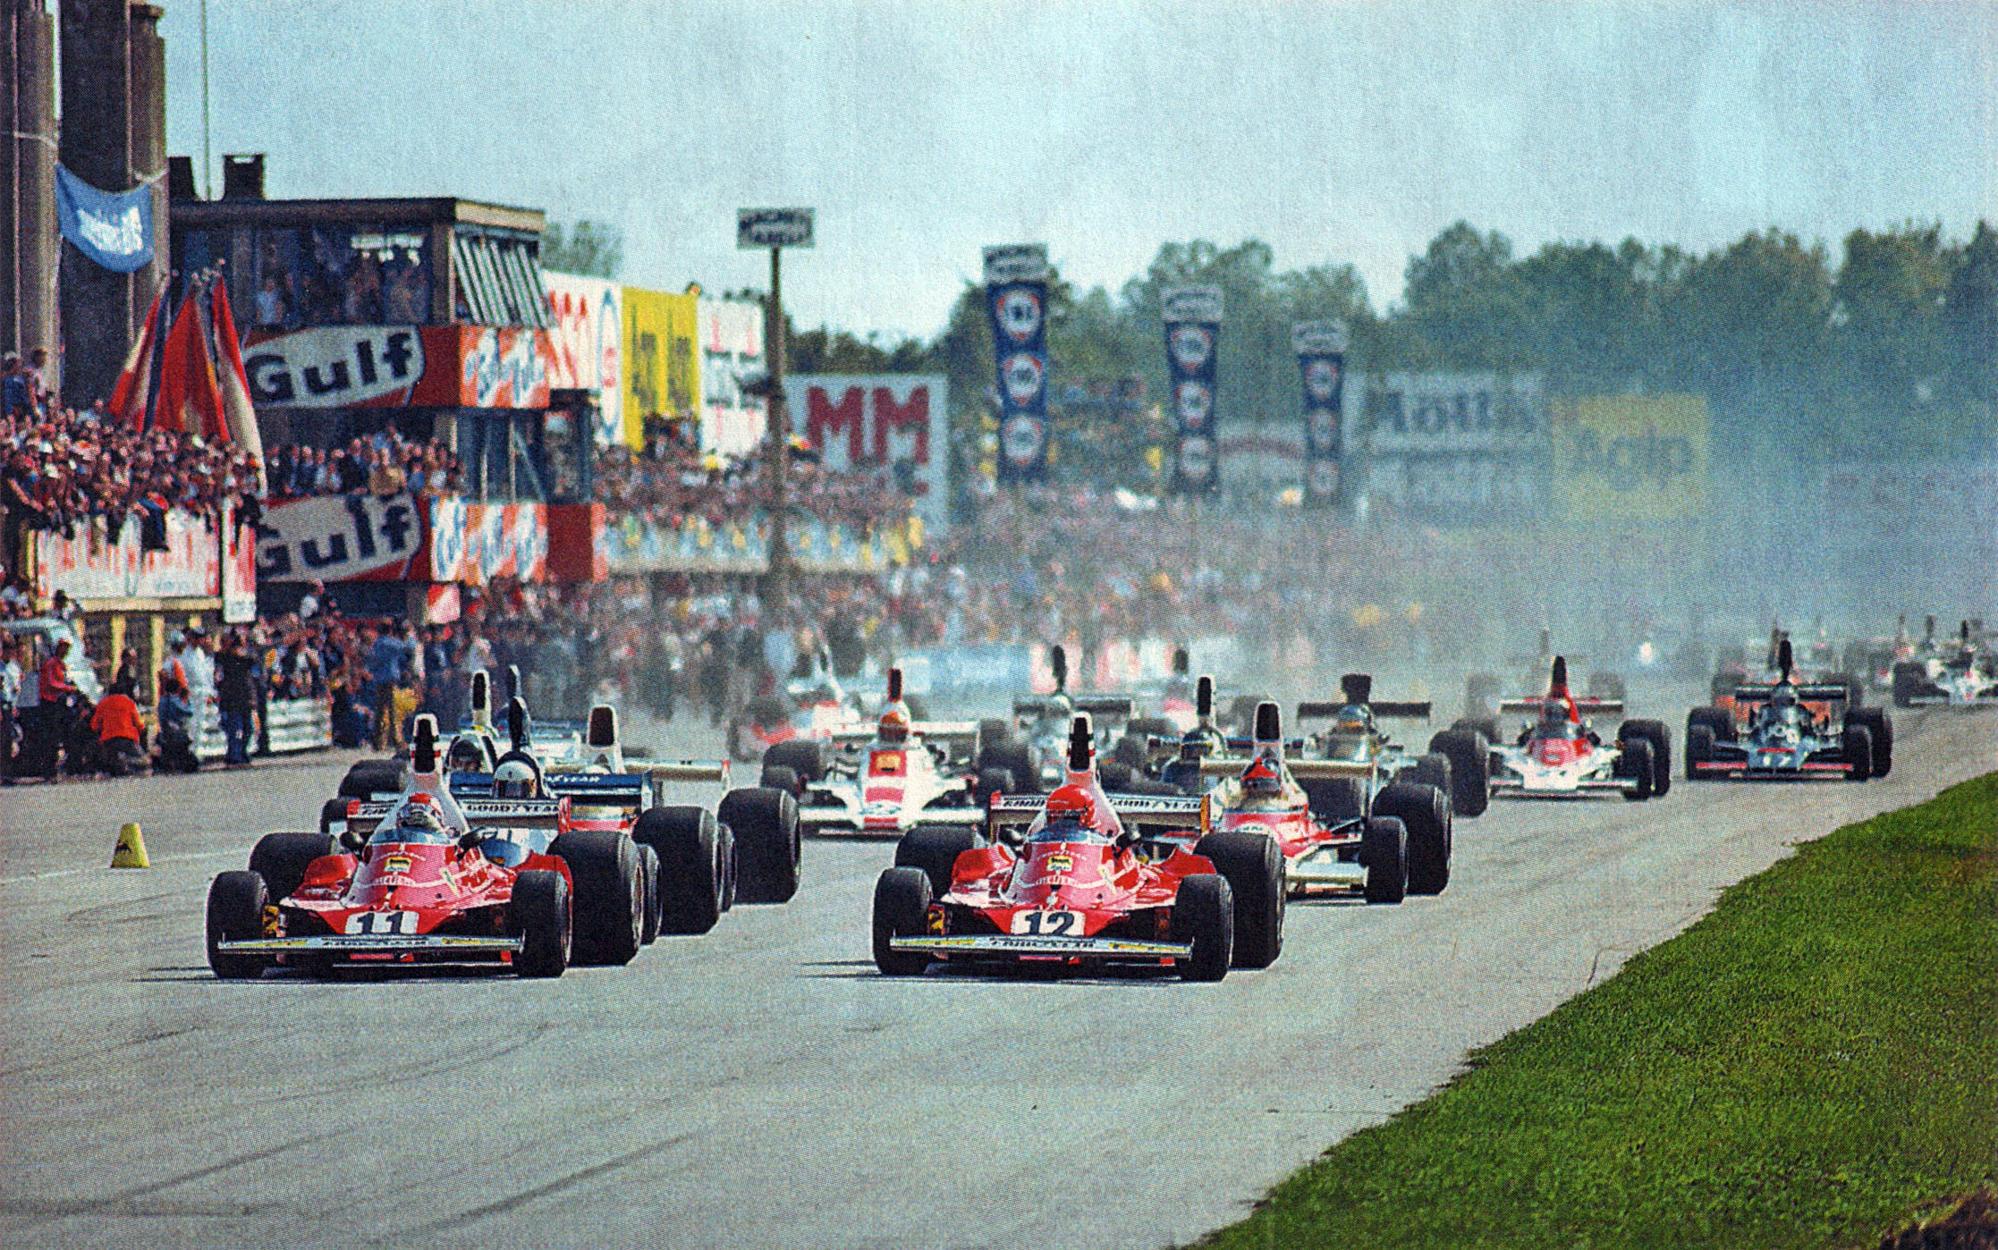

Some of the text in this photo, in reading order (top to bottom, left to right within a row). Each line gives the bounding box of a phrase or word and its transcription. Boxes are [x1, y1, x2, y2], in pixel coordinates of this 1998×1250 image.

[245, 331, 413, 403] Gulf
[256, 494, 412, 577] Gulf
[356, 912, 403, 935] 11
[1024, 911, 1075, 935] 12
